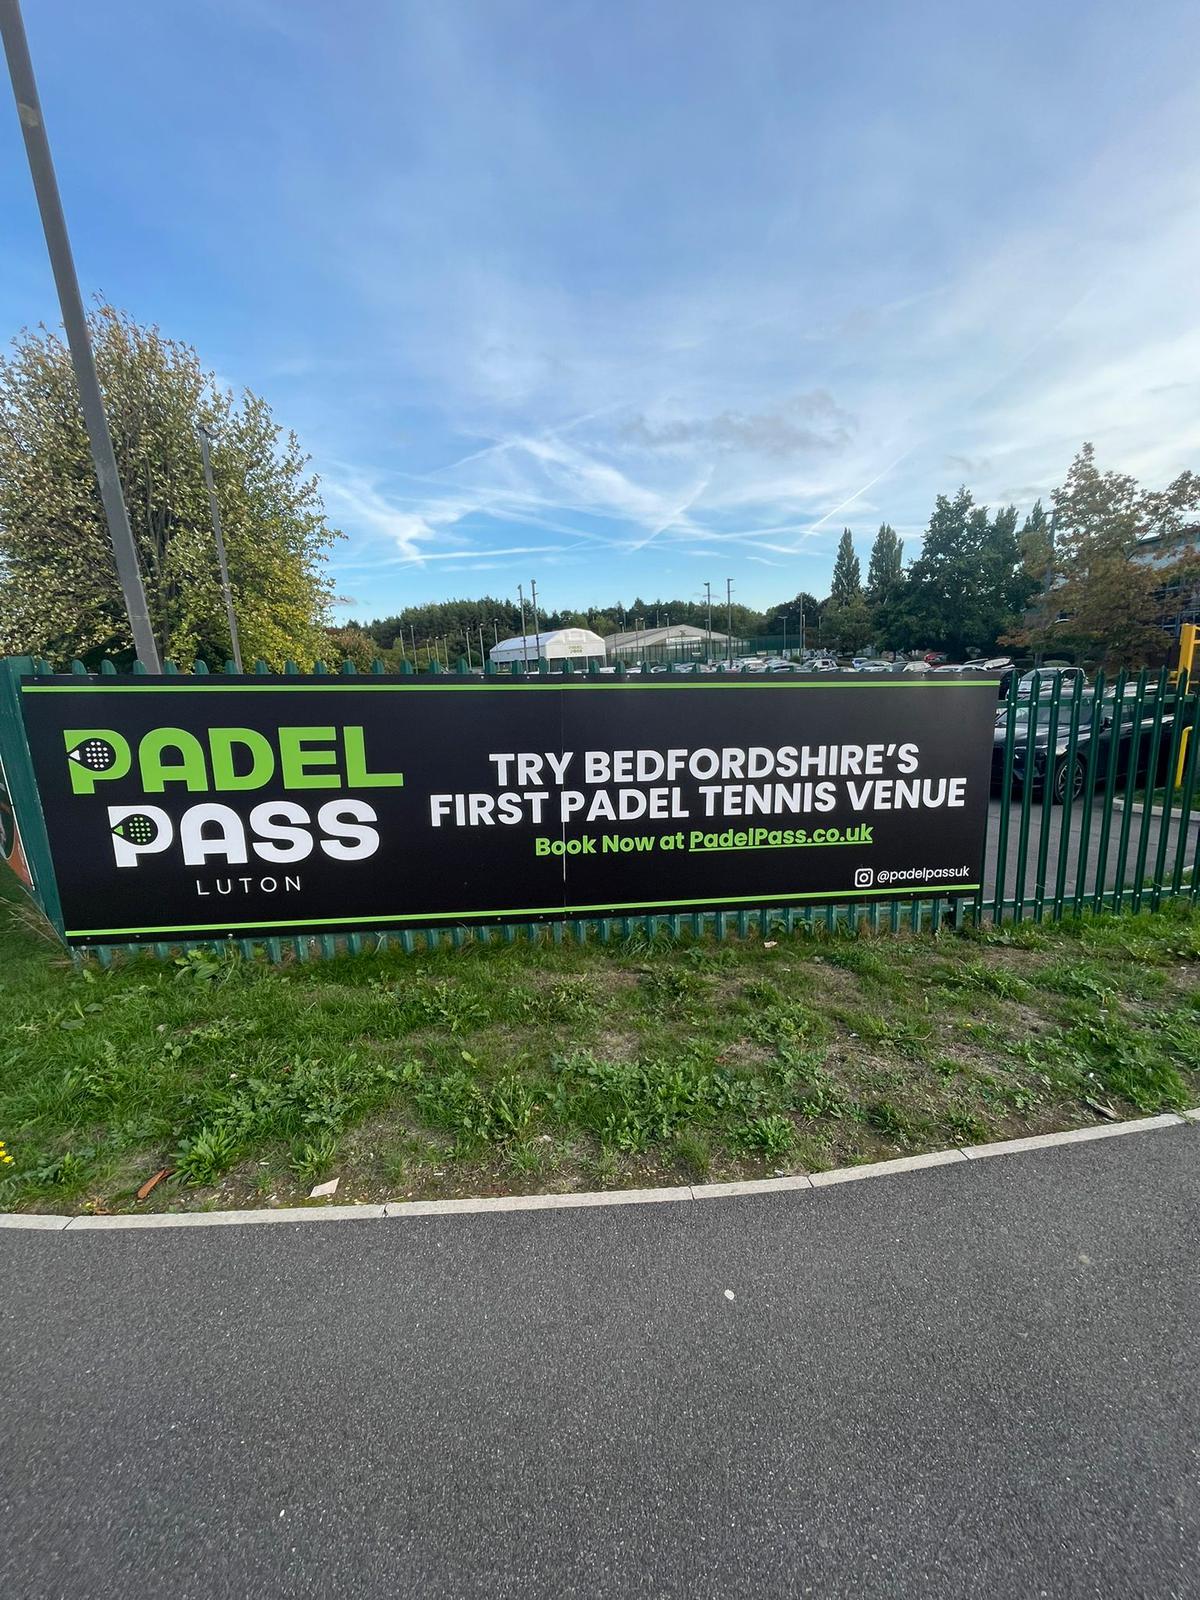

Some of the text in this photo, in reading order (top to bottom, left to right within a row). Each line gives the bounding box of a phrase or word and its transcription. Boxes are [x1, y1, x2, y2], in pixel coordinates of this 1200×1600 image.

[63, 726, 404, 795] PADEL
[489, 742, 920, 787] TRY BEDFORDSHIRE’S
[429, 777, 968, 827] FIRST PADEL TENNIS VENUE
[107, 798, 380, 868] PASS
[535, 823, 874, 856] Book Now at PadelPass.co.uk
[196, 875, 301, 896] LUTON
[876, 865, 970, 884] @padelpassuk
